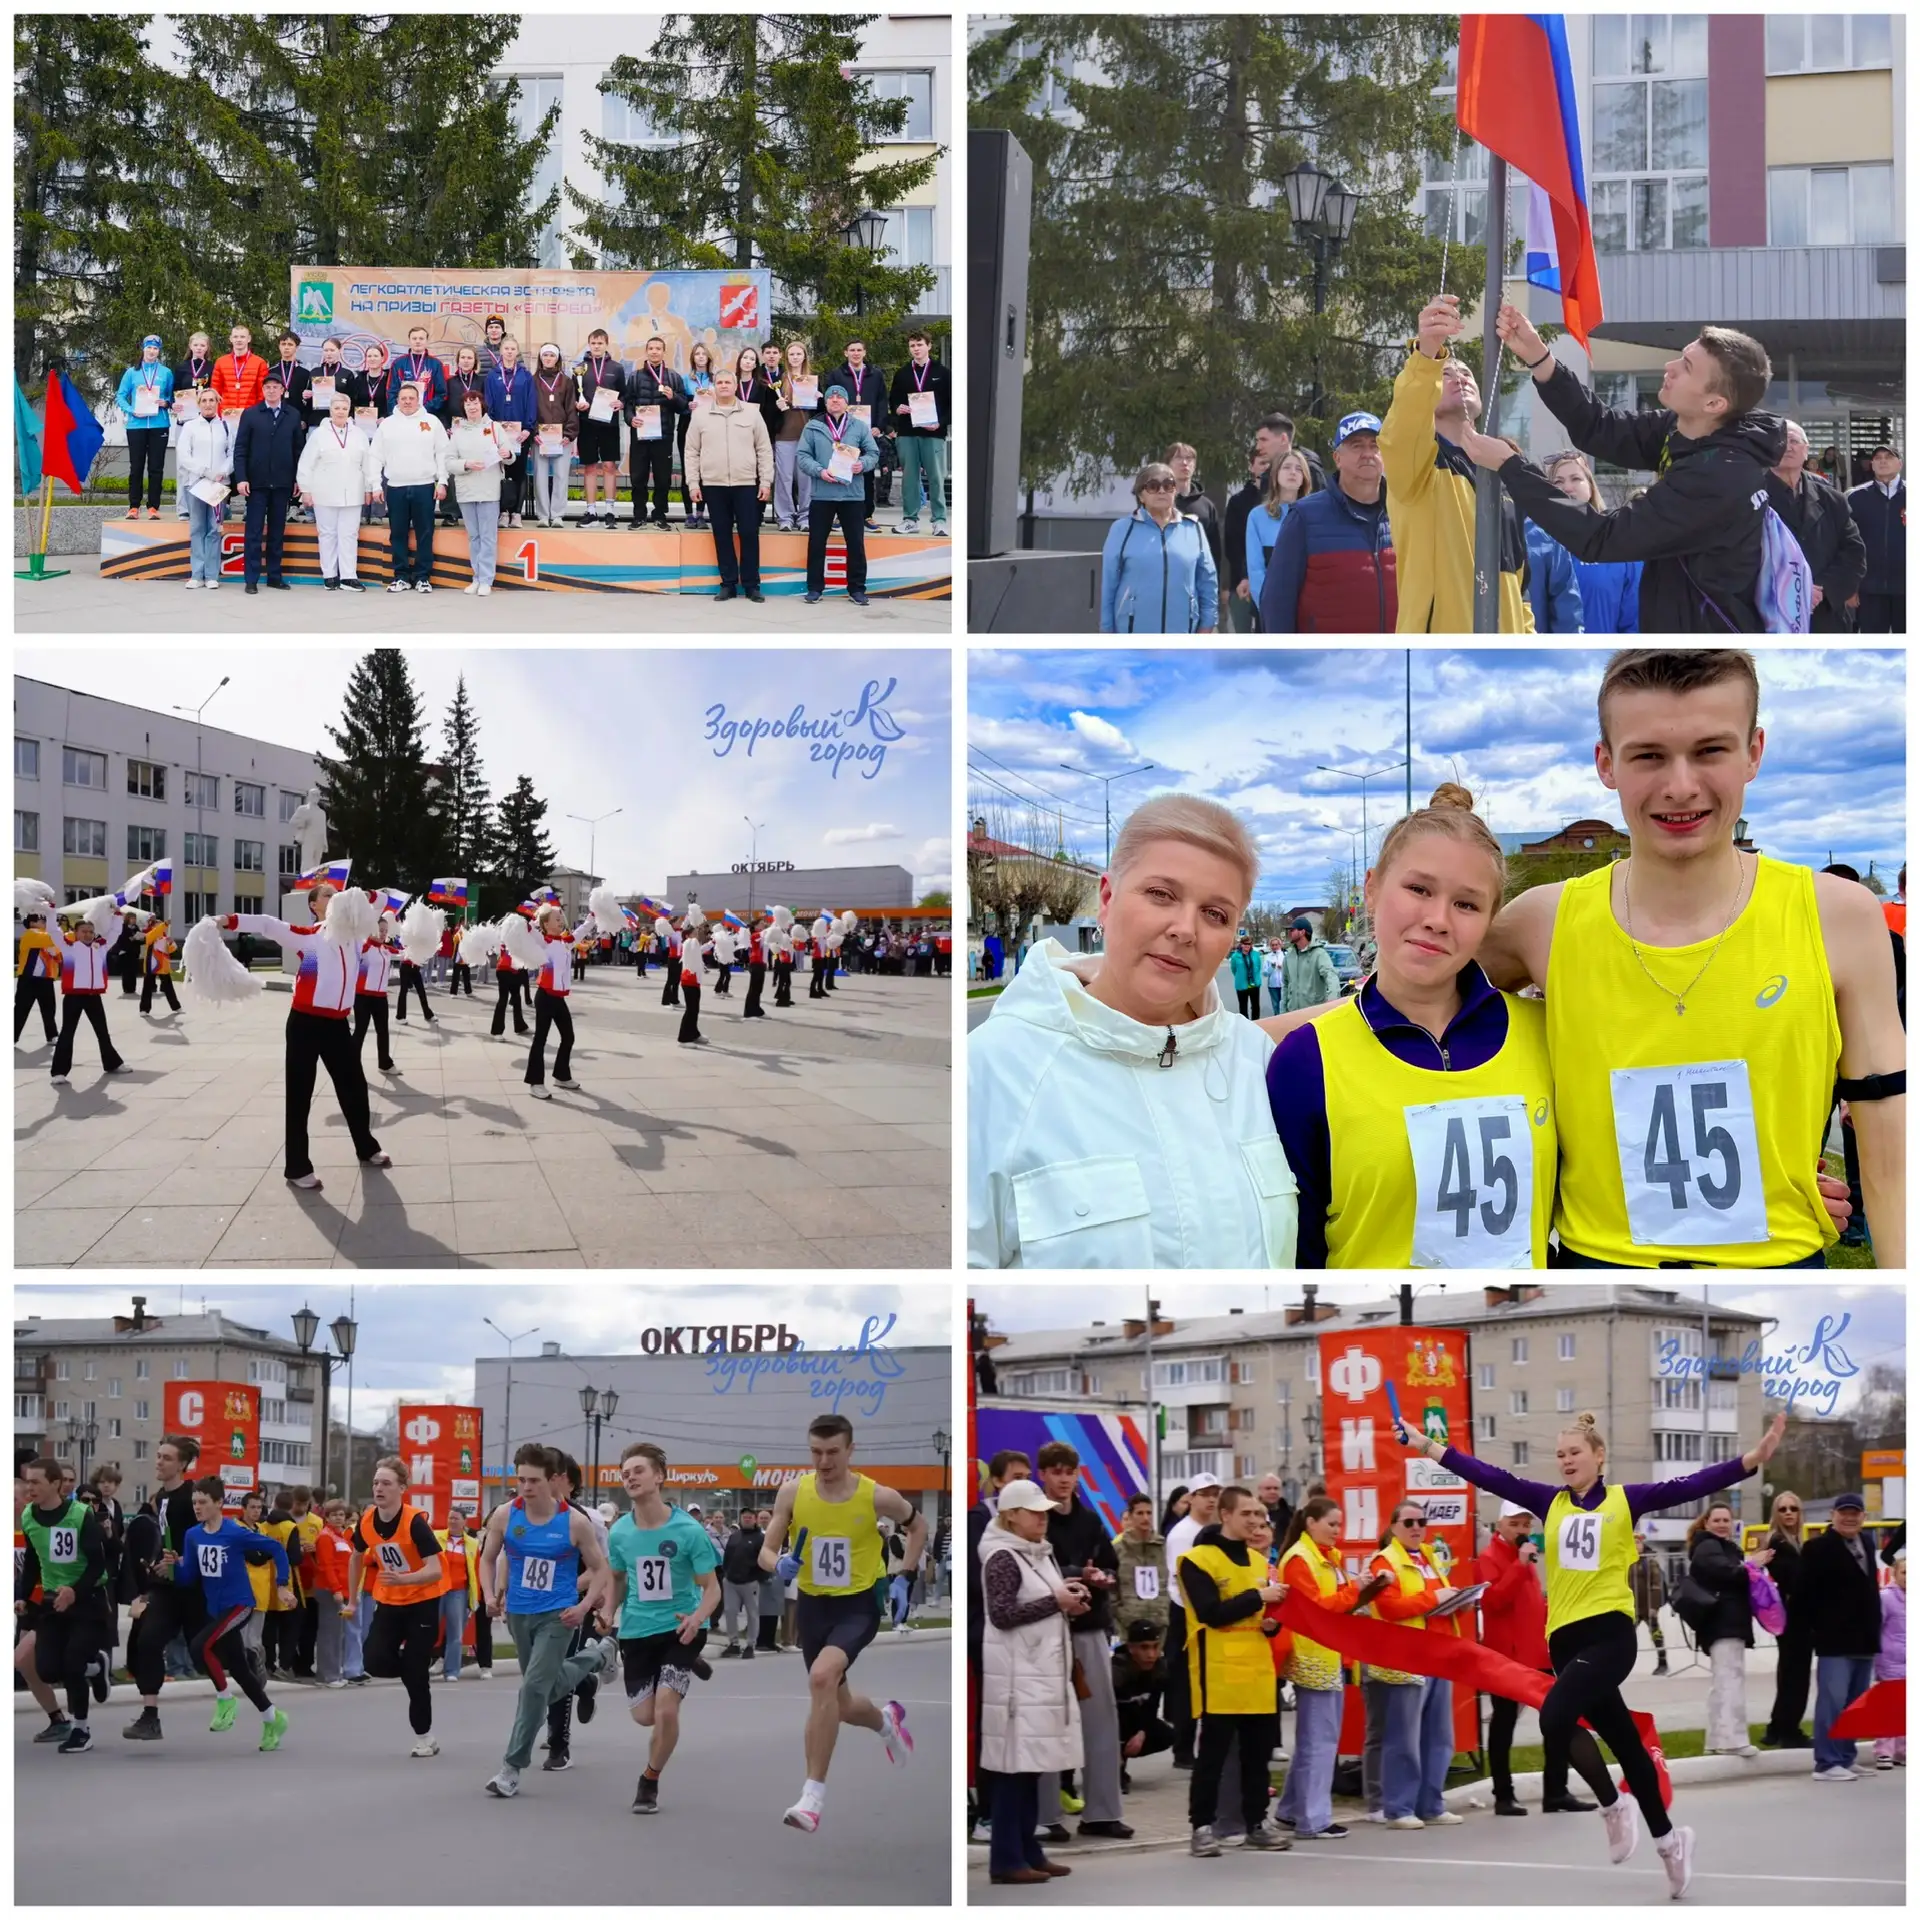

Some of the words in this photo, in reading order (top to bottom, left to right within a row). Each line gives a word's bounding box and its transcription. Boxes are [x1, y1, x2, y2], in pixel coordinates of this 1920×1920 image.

[350, 284, 511, 296] ЛЕГКОАТЛЕТИЧЕСКАЯ
[350, 300, 373, 312] НА
[377, 301, 437, 313] ПРИЗЫ
[440, 302, 509, 314] ГАЗЕТЫ
[515, 539, 539, 582] 1
[731, 860, 795, 875] ОКТЯБРЬ
[1644, 1082, 1741, 1210] 45
[1437, 1115, 1519, 1238] 45
[641, 1323, 800, 1356] ОКТЯБРЬ
[54, 1531, 74, 1557] 39
[1565, 1517, 1596, 1560] 45
[201, 1546, 218, 1574] 43
[381, 1546, 403, 1568] 40
[818, 1541, 846, 1578] 45
[525, 1558, 550, 1590] 48
[643, 1560, 666, 1591] 37
